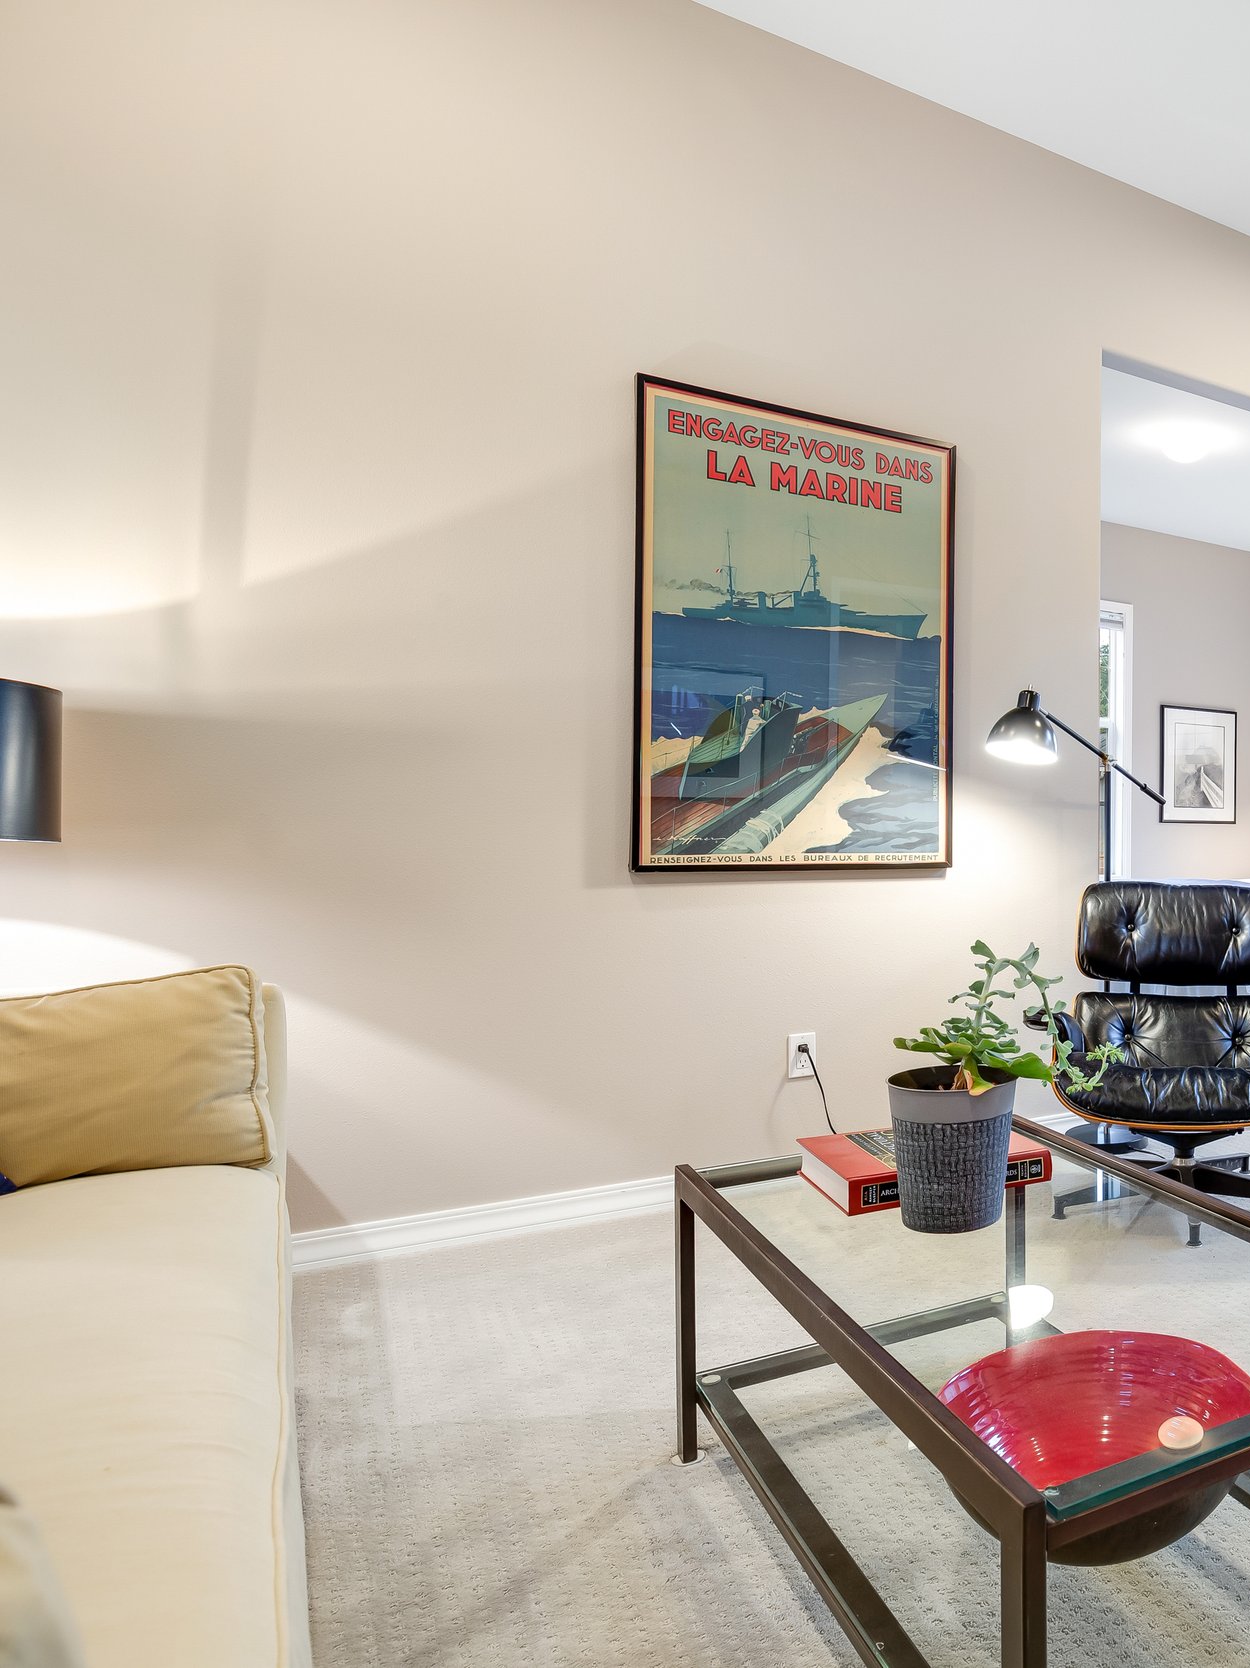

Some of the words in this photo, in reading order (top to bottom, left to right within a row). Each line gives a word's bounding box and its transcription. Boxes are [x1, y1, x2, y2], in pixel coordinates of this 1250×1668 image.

[667, 408, 866, 471] ENGAGEZ-VOUS
[875, 452, 934, 484] DANS
[706, 449, 756, 488] LA
[770, 461, 903, 514] MARINE
[650, 855, 743, 864] RENSEIGNEZ-VOUS
[749, 855, 773, 863] DANS
[803, 854, 853, 862] BUREAUX
